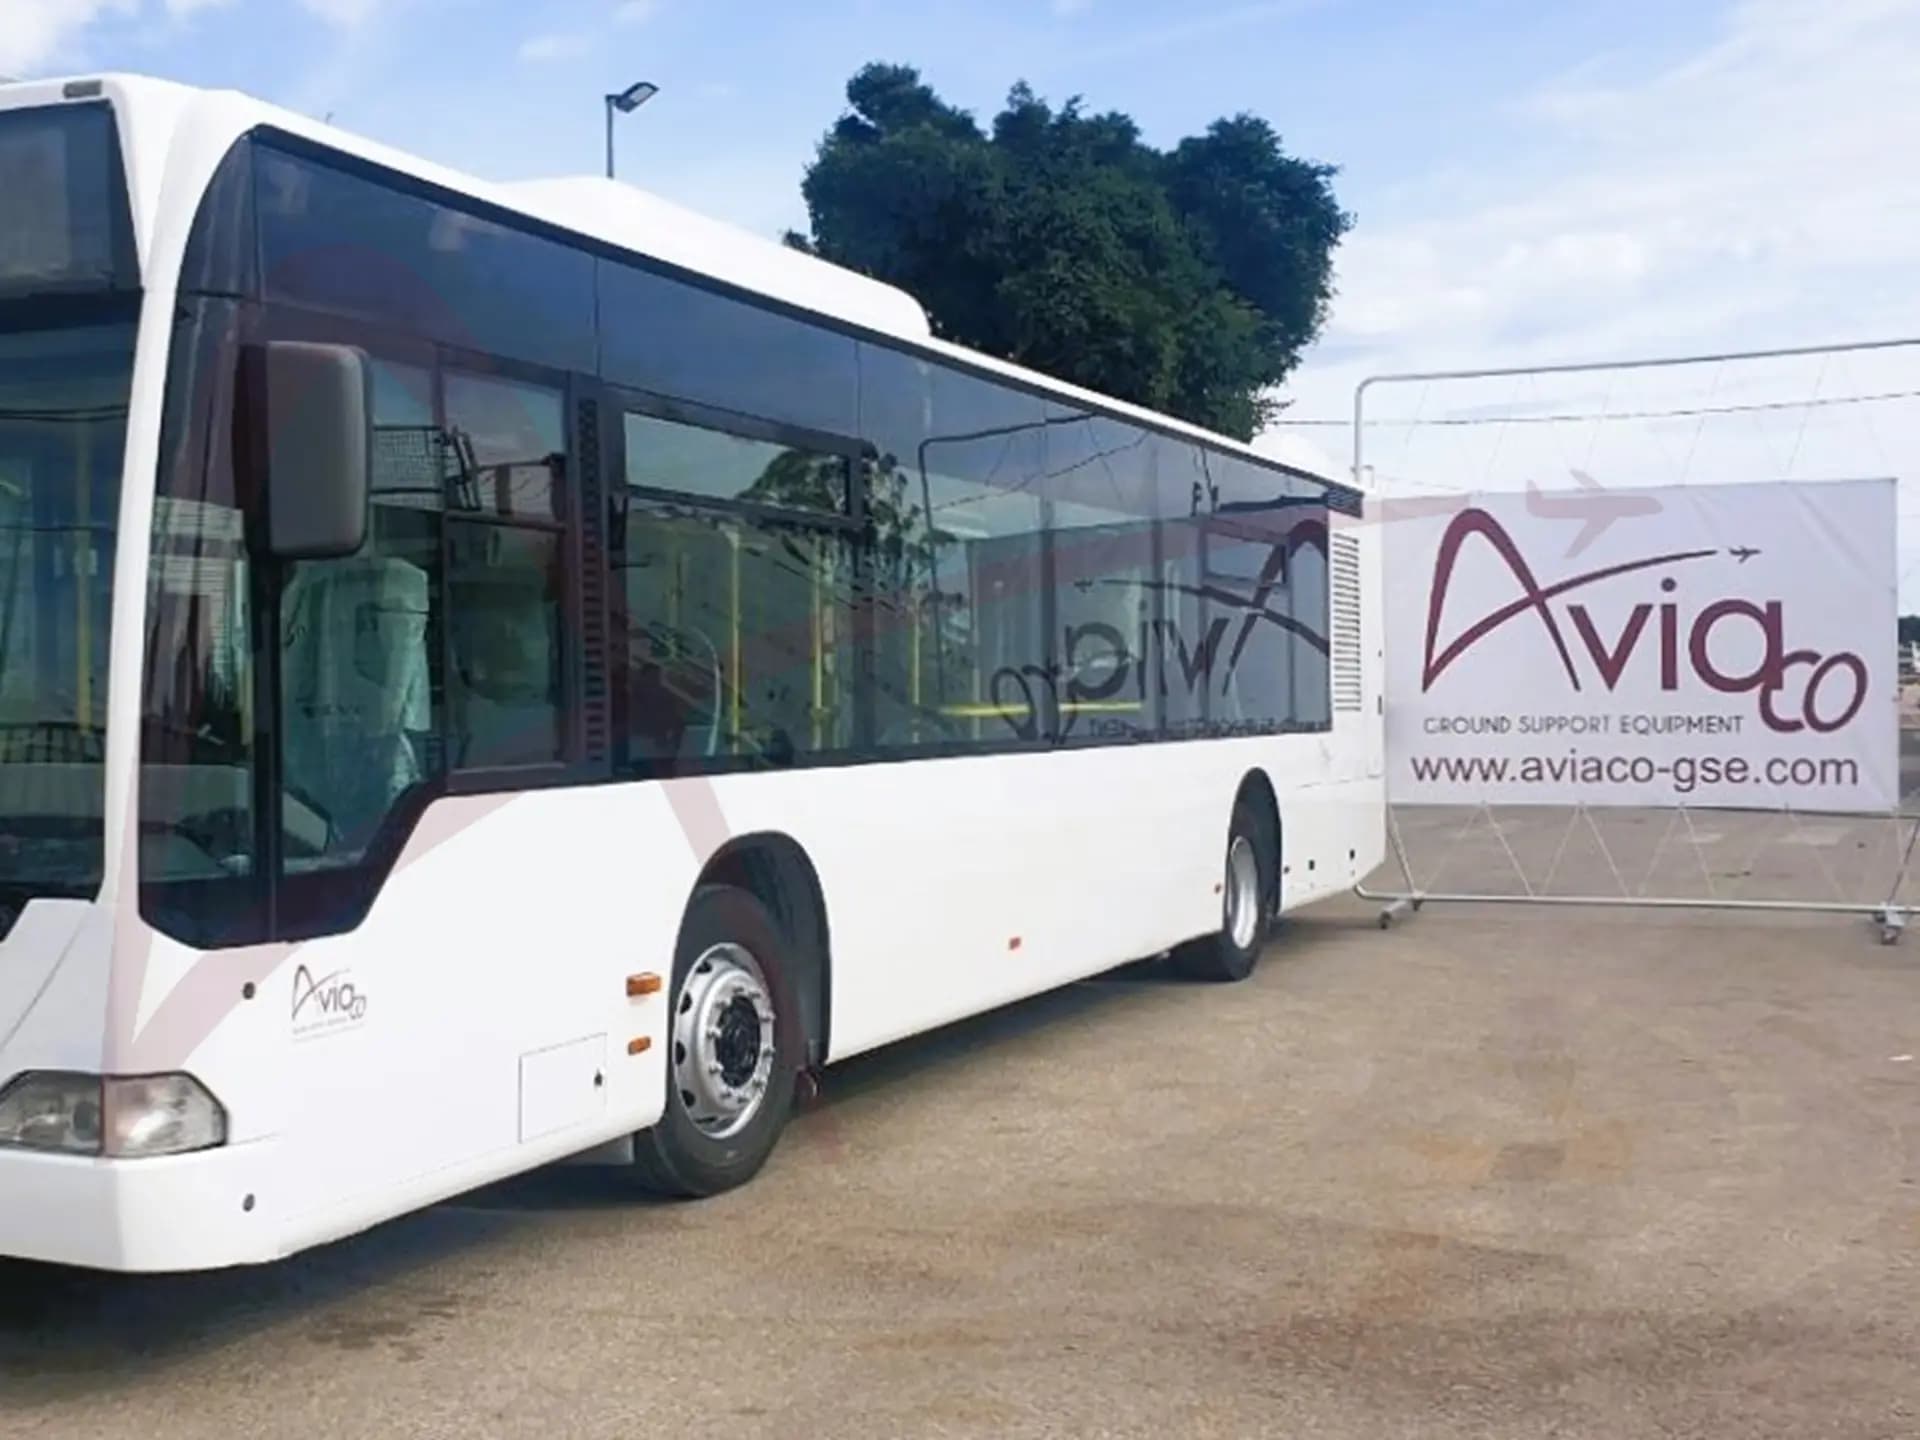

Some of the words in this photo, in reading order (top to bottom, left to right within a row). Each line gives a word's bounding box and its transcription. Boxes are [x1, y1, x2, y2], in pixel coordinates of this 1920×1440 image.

[1423, 715, 1512, 735] GROUND
[1519, 714, 1610, 735] SUPPORT
[1620, 714, 1745, 735] EQUIPMENT
[1411, 748, 1859, 793] www.aviaco-gse.com
